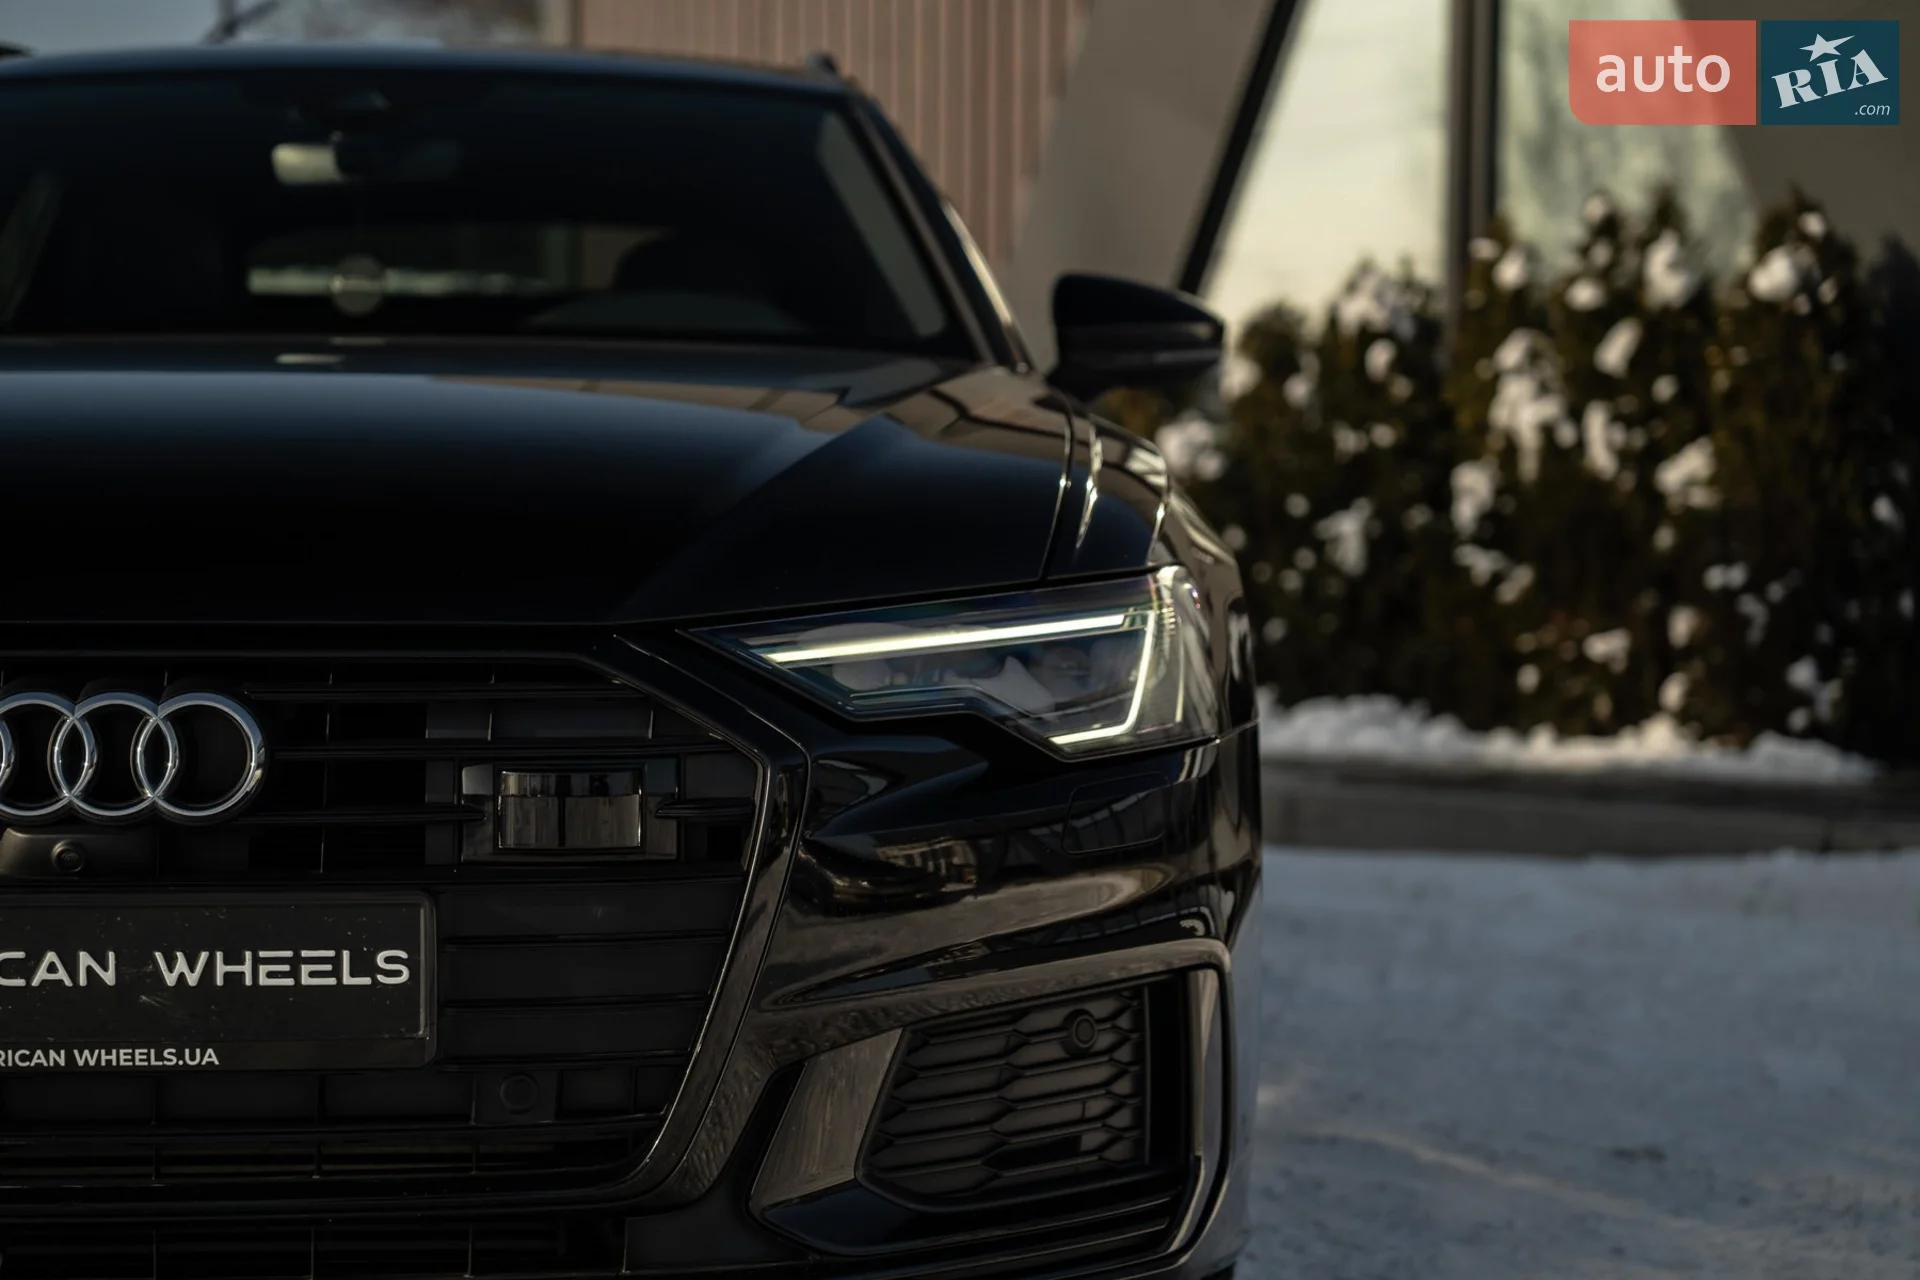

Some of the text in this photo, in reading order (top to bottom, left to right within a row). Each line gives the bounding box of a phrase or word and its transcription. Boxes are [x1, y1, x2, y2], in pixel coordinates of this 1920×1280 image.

[0, 950, 411, 988] CAN WHEELS
[73, 1048, 220, 1067] WHEELS.UA
